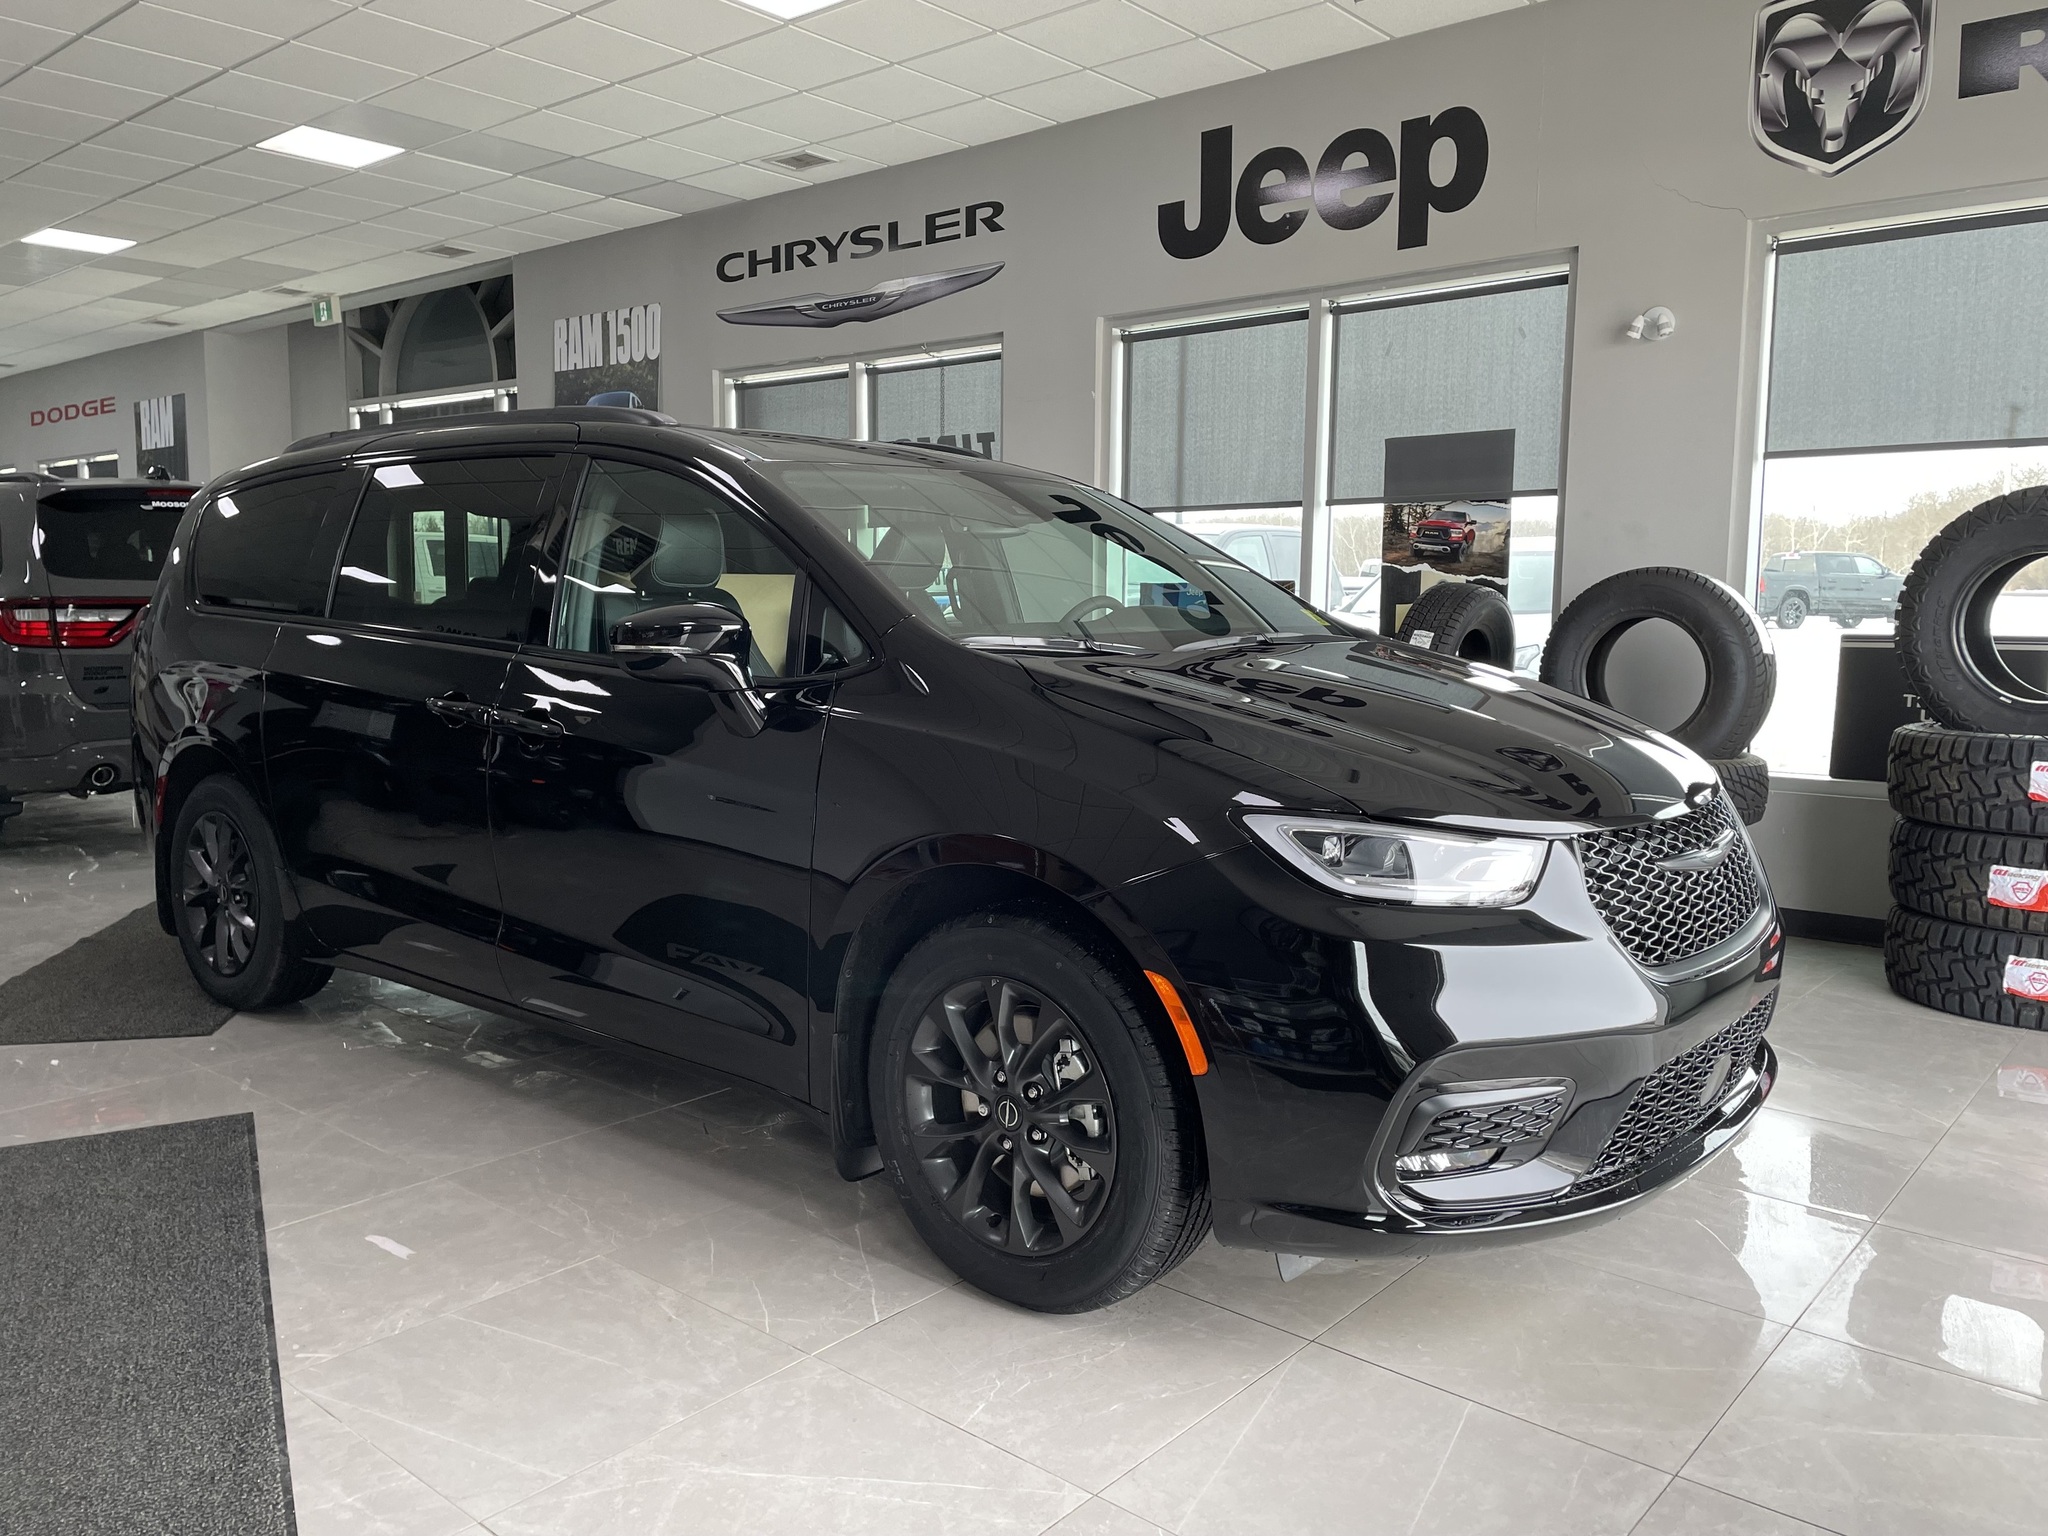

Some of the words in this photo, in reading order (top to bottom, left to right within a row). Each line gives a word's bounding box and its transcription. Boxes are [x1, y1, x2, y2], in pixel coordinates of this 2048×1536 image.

[1157, 105, 1489, 260] Jeep
[716, 201, 1005, 283] CHRYSLER
[821, 296, 877, 311] CHRYSLER
[554, 312, 603, 372] RAM
[606, 303, 661, 365] 1500
[31, 397, 116, 426] DODGE
[139, 395, 174, 450] RAM
[151, 500, 189, 508] MOOSO
[1186, 588, 1204, 597] Jeep
